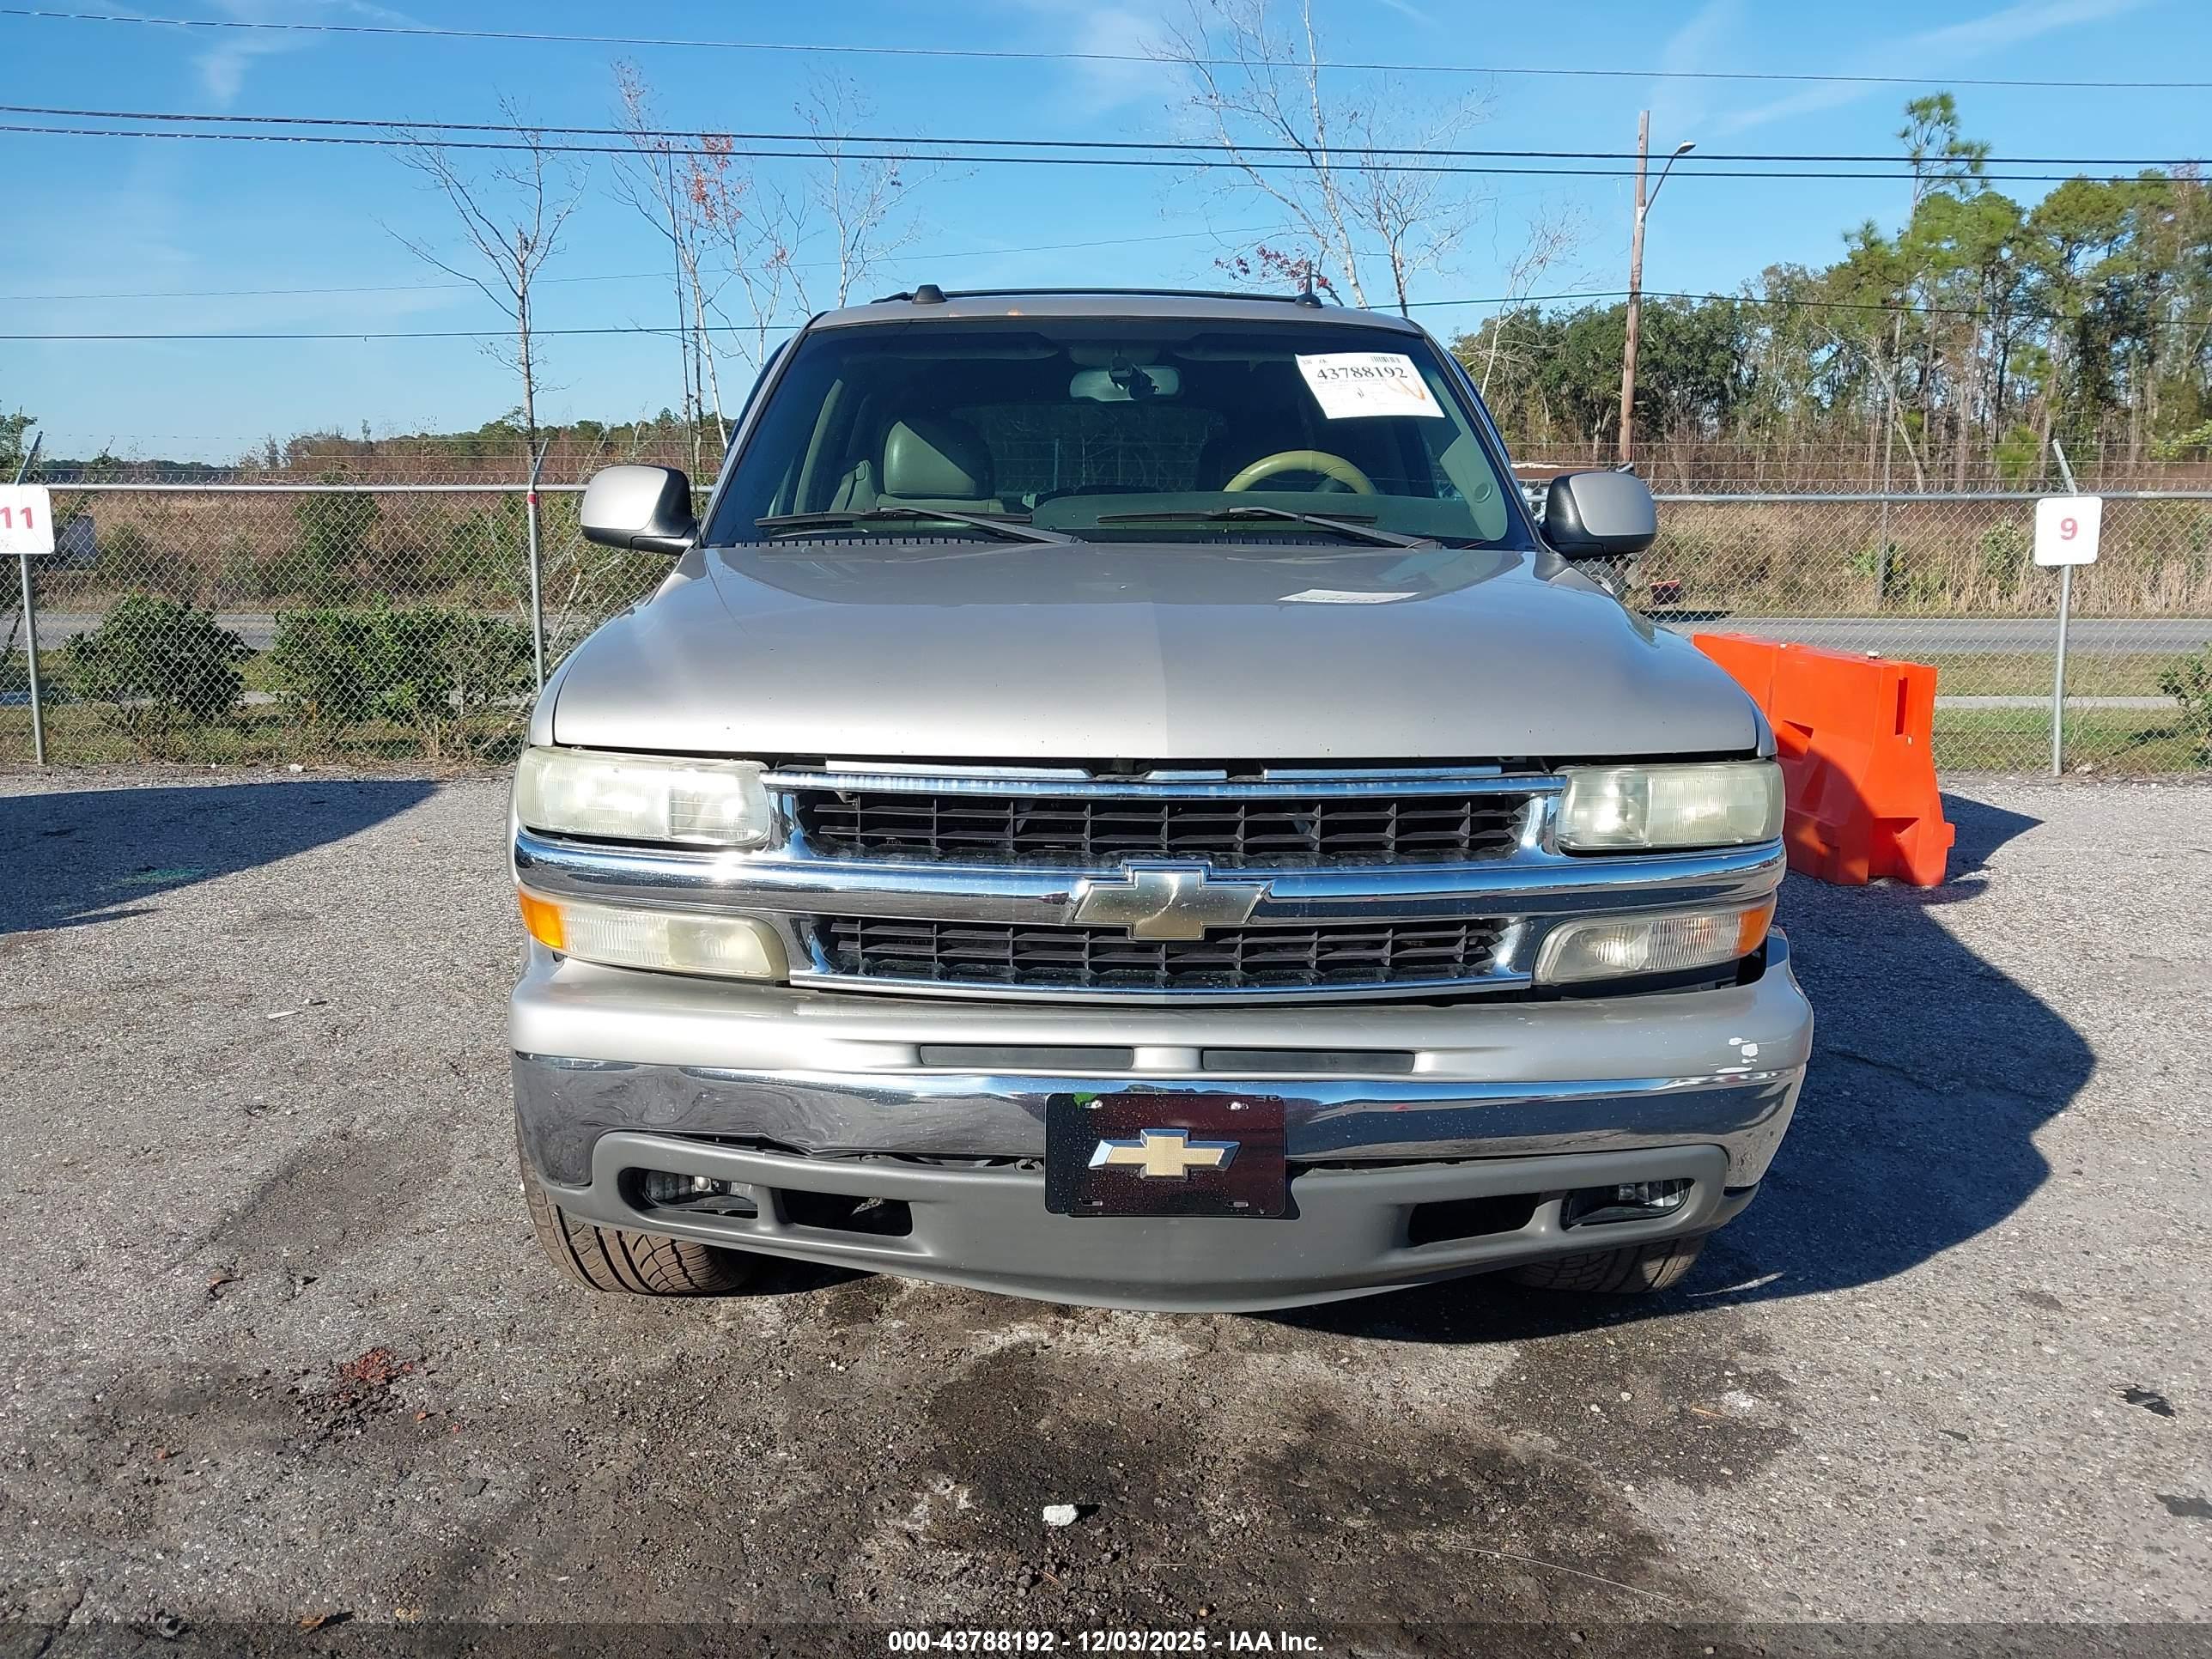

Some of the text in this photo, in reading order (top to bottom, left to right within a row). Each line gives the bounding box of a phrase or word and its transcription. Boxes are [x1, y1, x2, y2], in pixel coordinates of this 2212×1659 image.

[1317, 366, 1408, 380] 43788192
[0, 507, 33, 529] 11
[2060, 518, 2078, 540] 9
